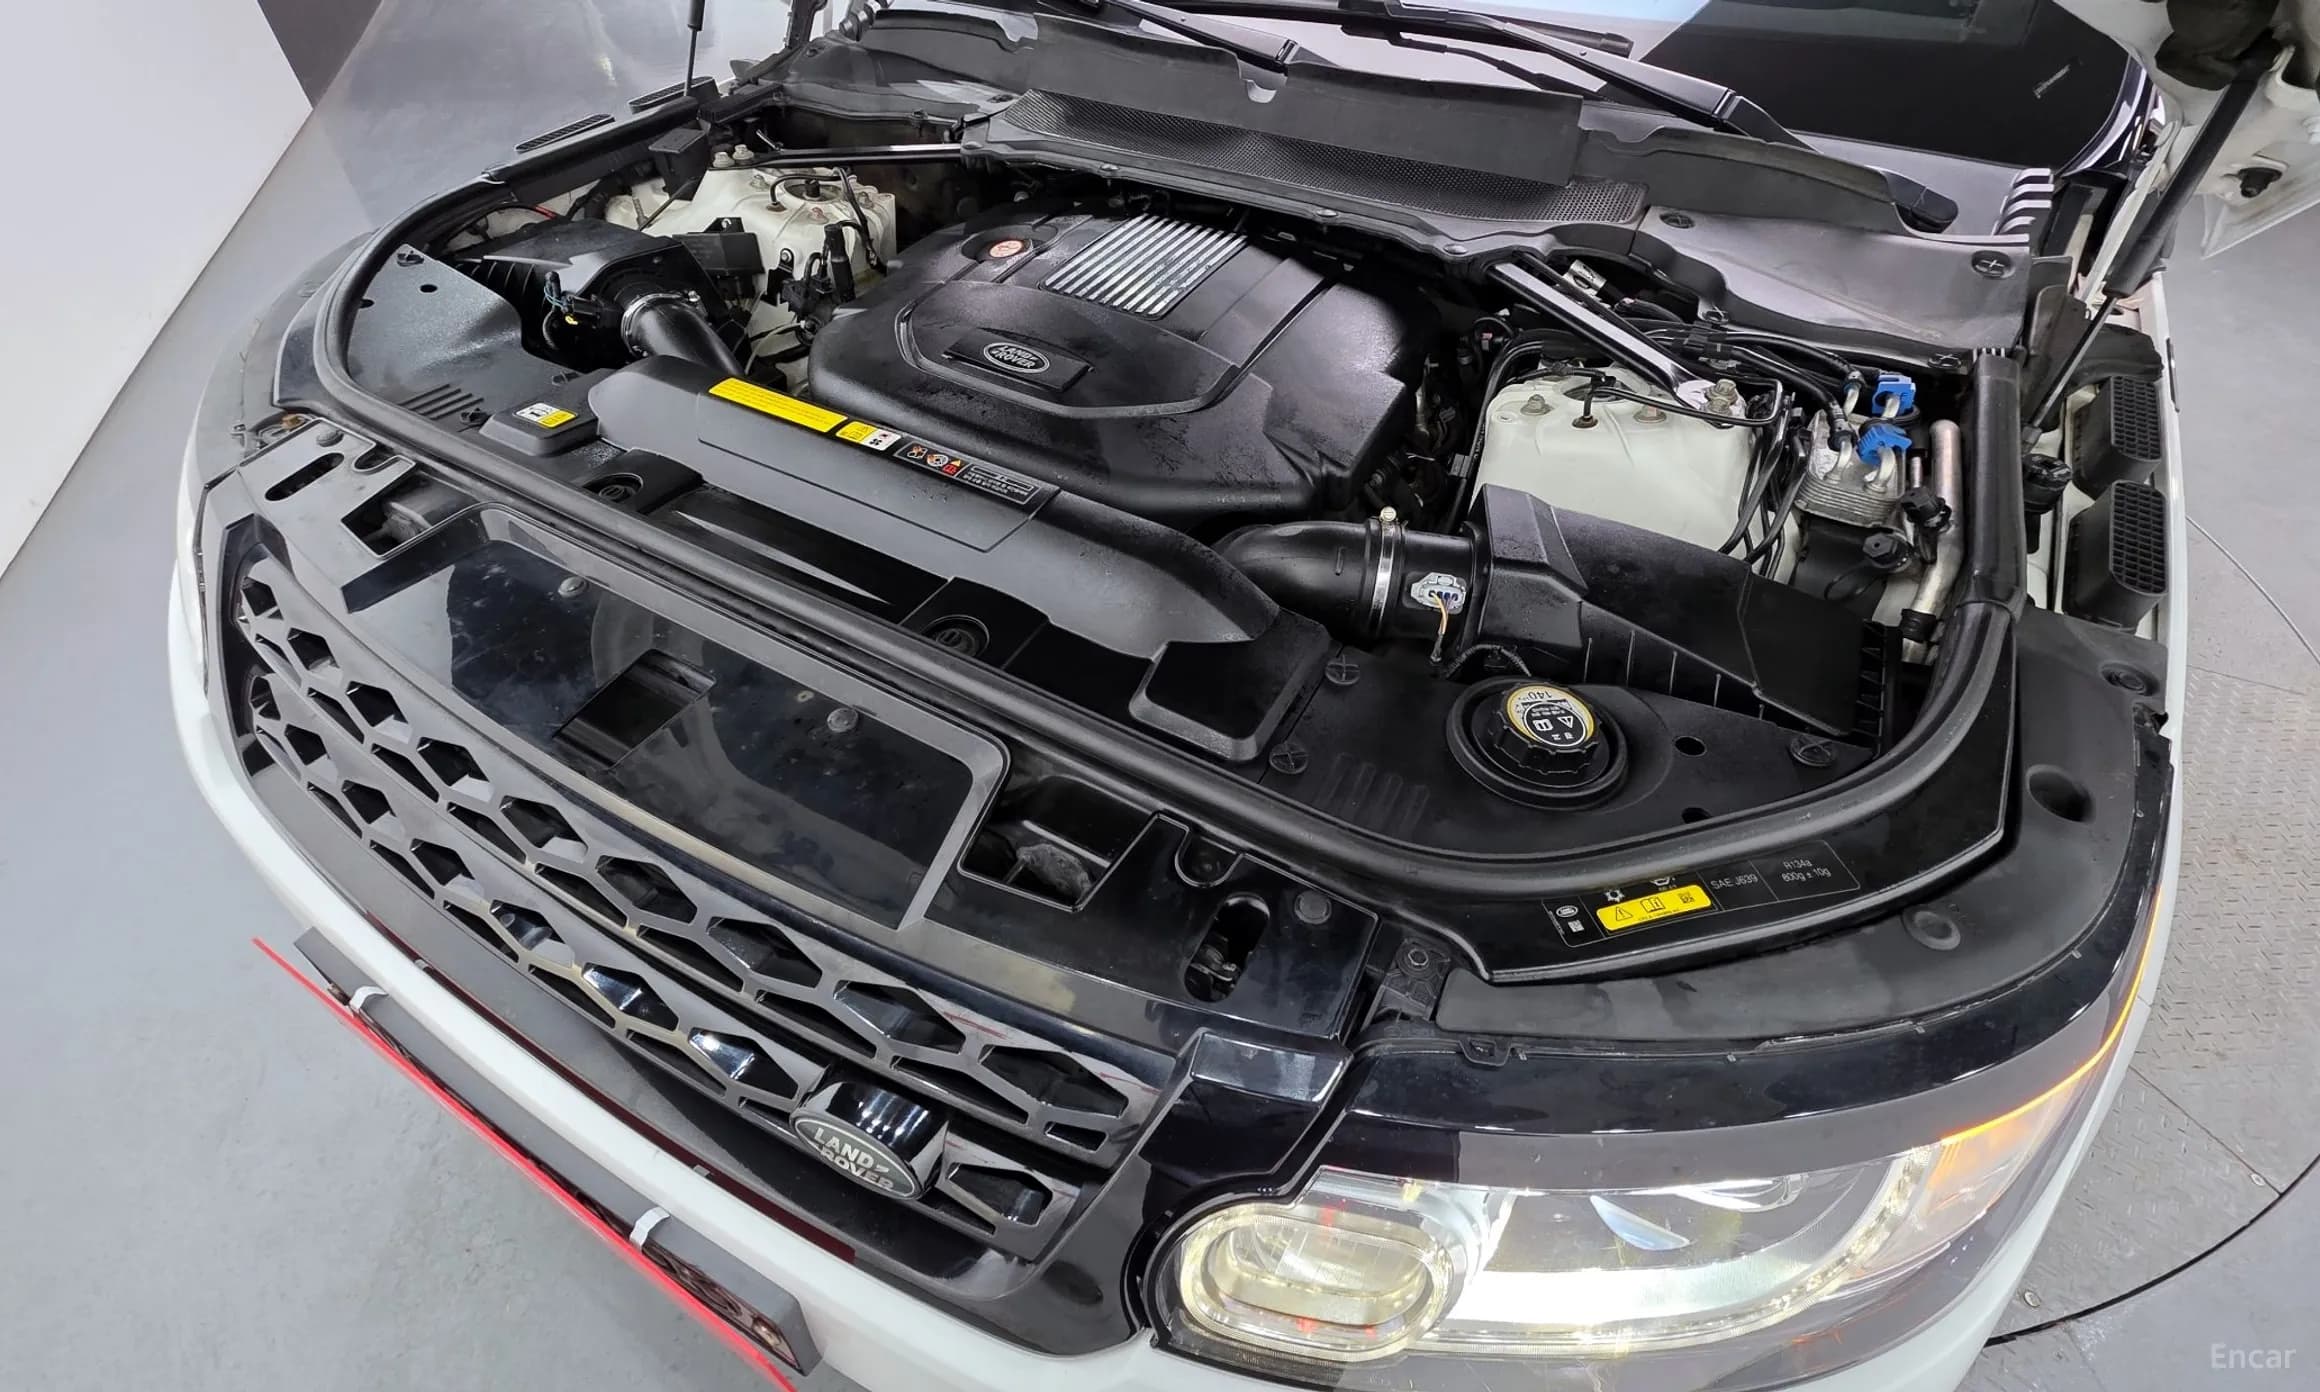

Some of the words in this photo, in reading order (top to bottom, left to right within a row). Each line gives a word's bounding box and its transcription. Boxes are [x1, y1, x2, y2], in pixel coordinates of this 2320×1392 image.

[994, 351, 1036, 368] ROVER
[999, 345, 1033, 359] LAND
[1710, 878, 1733, 889] SAE
[814, 1127, 875, 1169] LAND
[821, 1144, 894, 1189] ROVER
